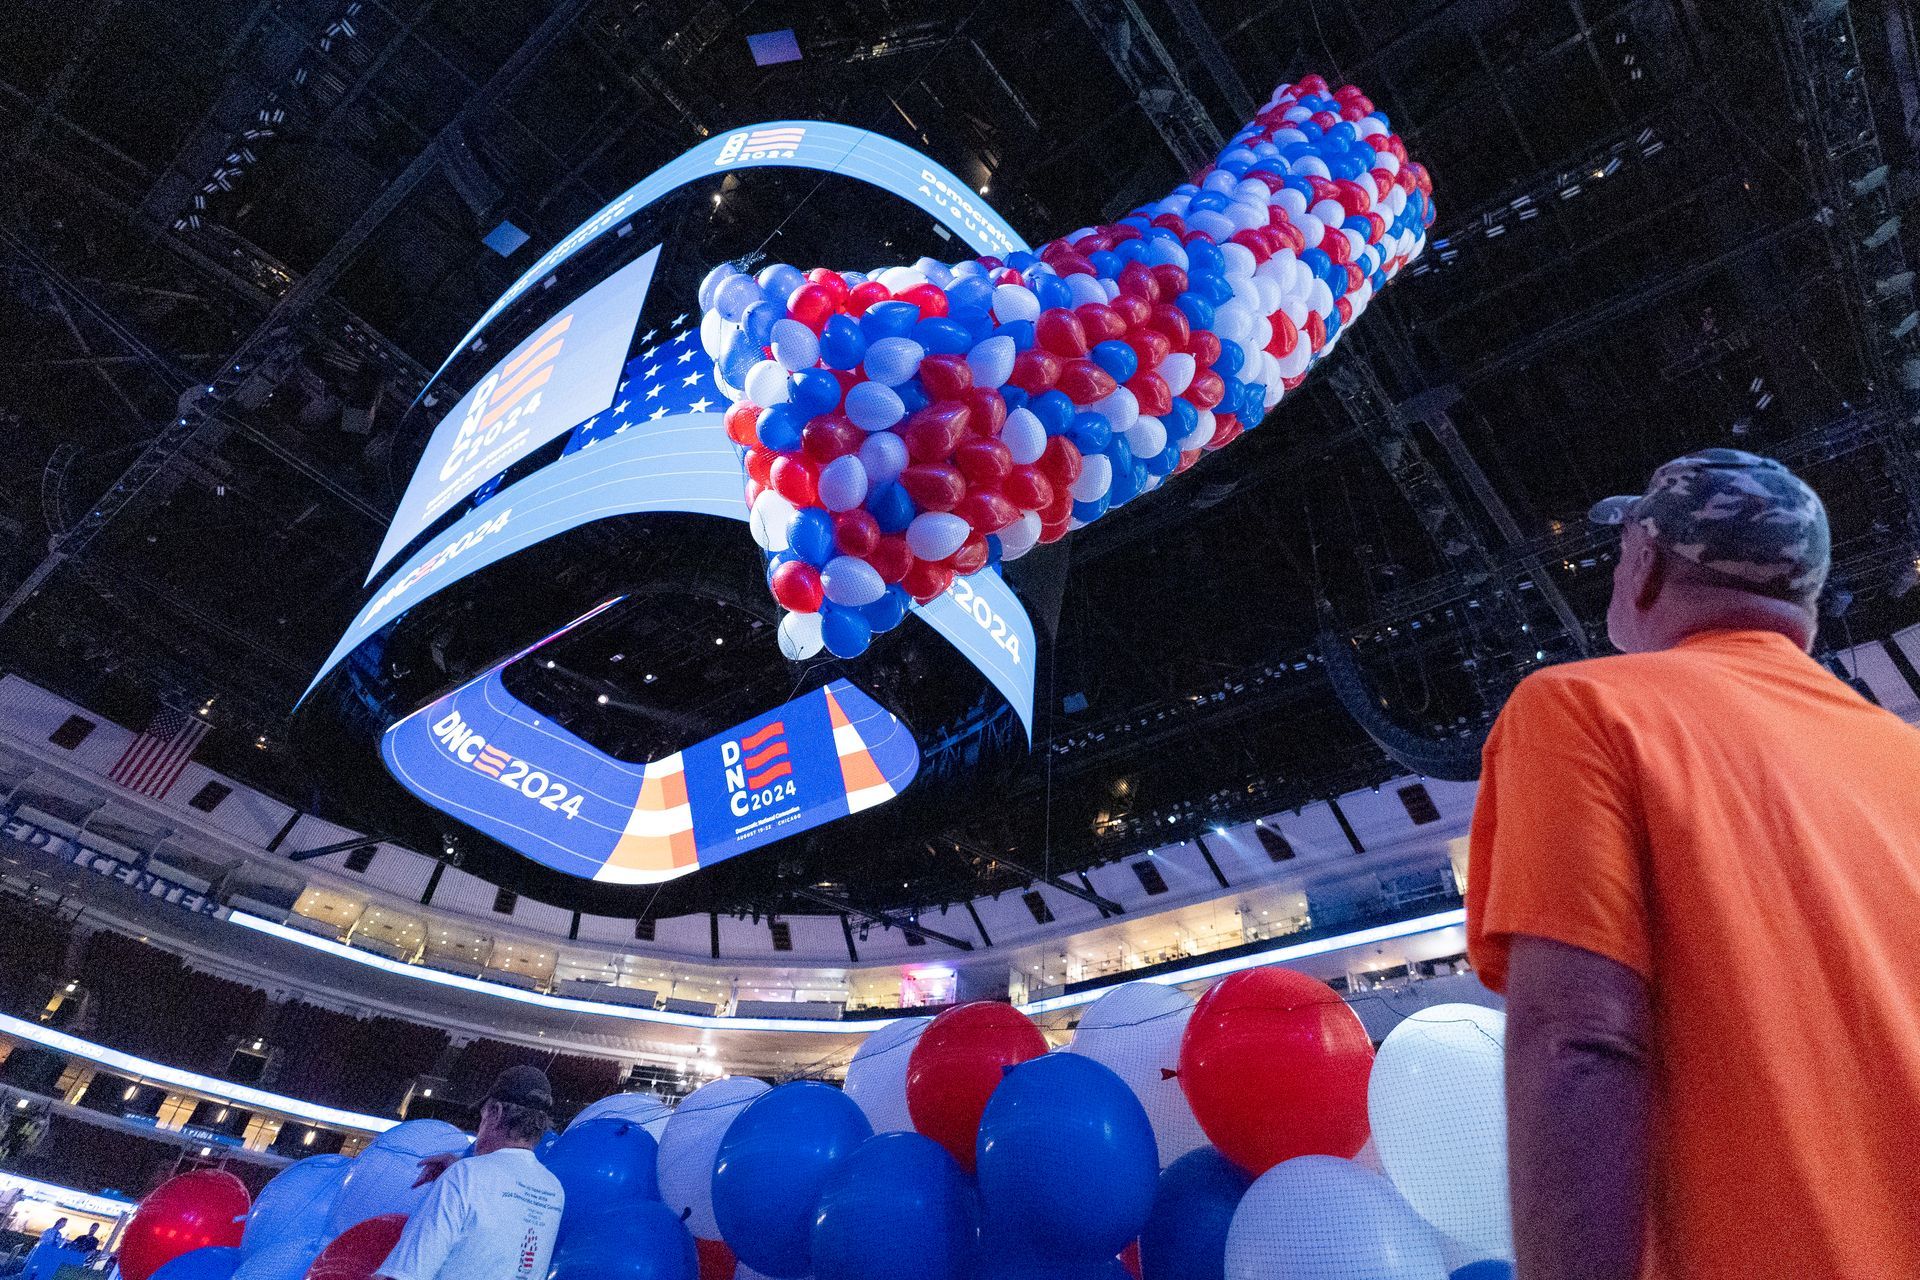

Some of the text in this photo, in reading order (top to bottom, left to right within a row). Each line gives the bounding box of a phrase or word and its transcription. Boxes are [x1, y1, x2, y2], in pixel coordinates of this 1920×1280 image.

[737, 149, 796, 162] 2024
[917, 184, 1001, 252] AUGUST
[920, 169, 1014, 253] Democratic
[439, 373, 499, 482] DNC
[465, 391, 542, 462] 2024
[431, 508, 513, 572] 2024
[954, 578, 1021, 665] 2024
[432, 710, 585, 820] DNC 2024
[721, 740, 750, 817] DNC
[751, 779, 797, 811] 2024
[736, 830, 757, 841] AUGUST
[777, 813, 802, 826] CHICAGO
[88, 852, 217, 918] CENTER
